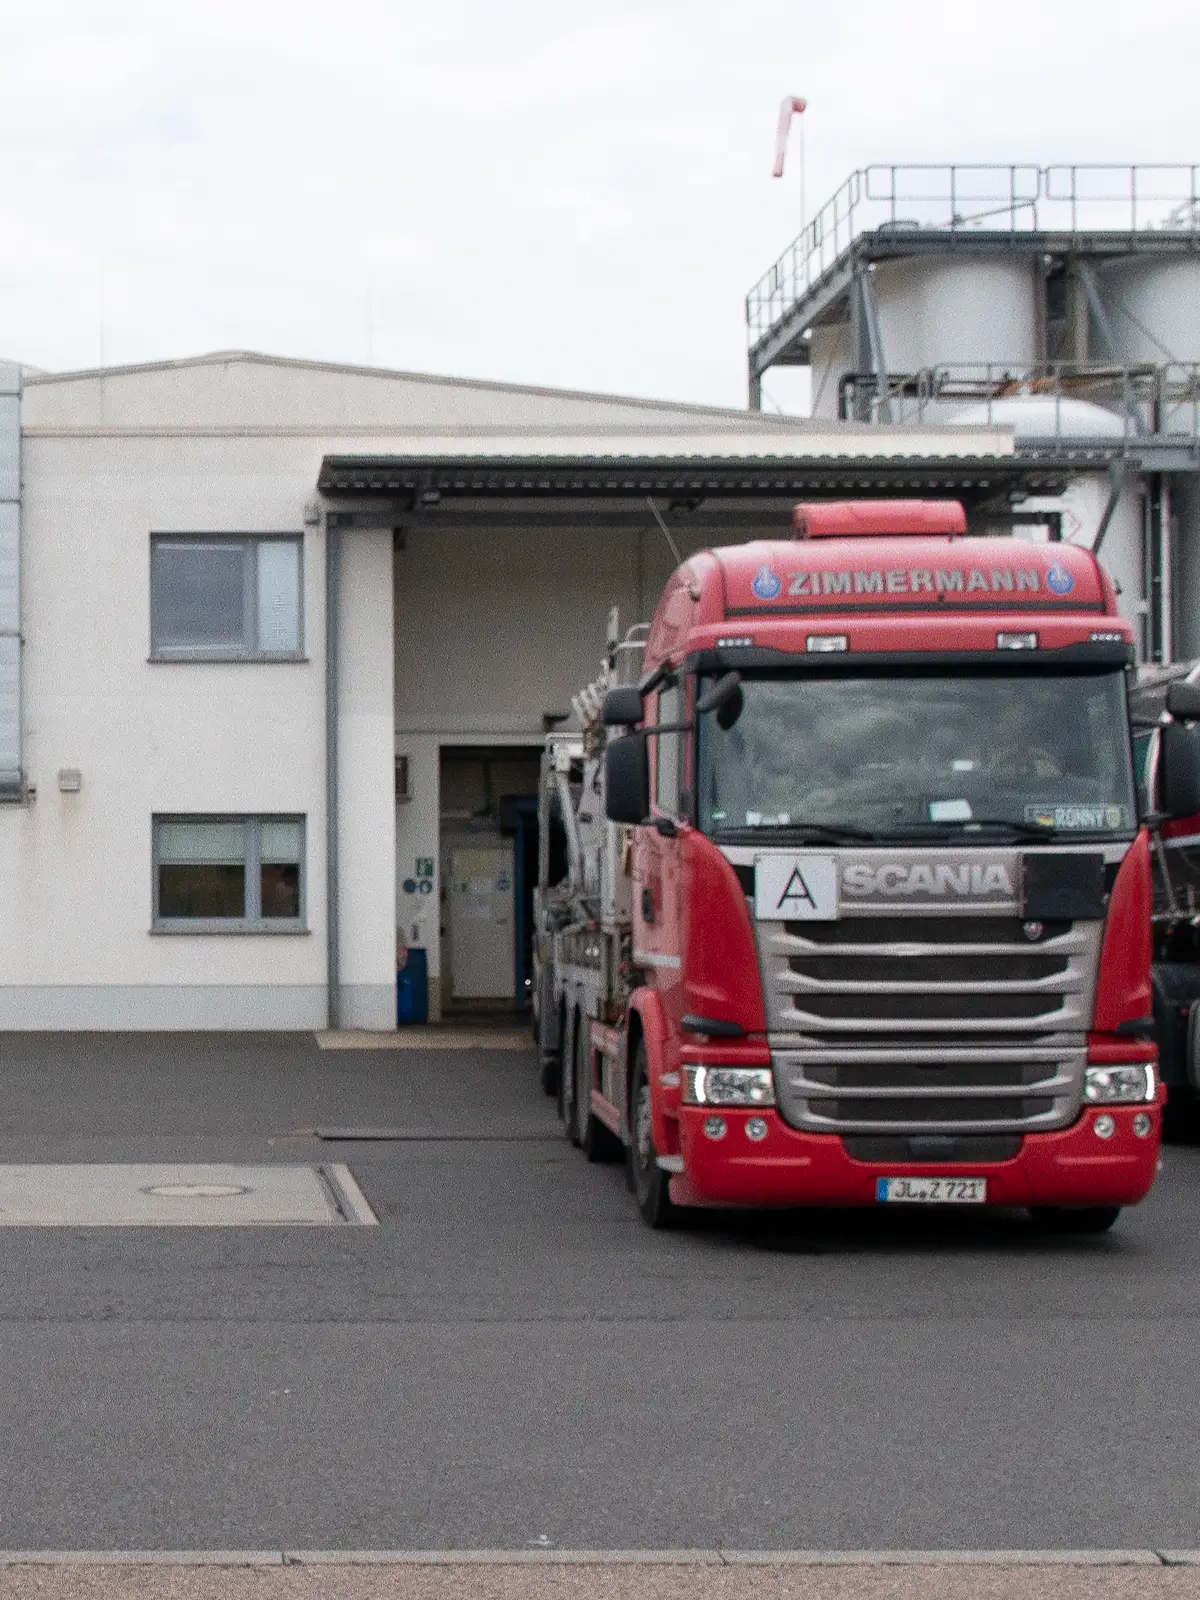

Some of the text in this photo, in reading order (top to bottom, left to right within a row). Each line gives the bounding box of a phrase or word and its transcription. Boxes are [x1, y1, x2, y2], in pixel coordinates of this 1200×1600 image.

[788, 569, 1040, 596] ZIMMERMANN
[776, 867, 817, 909] A
[842, 864, 1012, 895] SCANIA
[945, 1182, 978, 1199] 721
